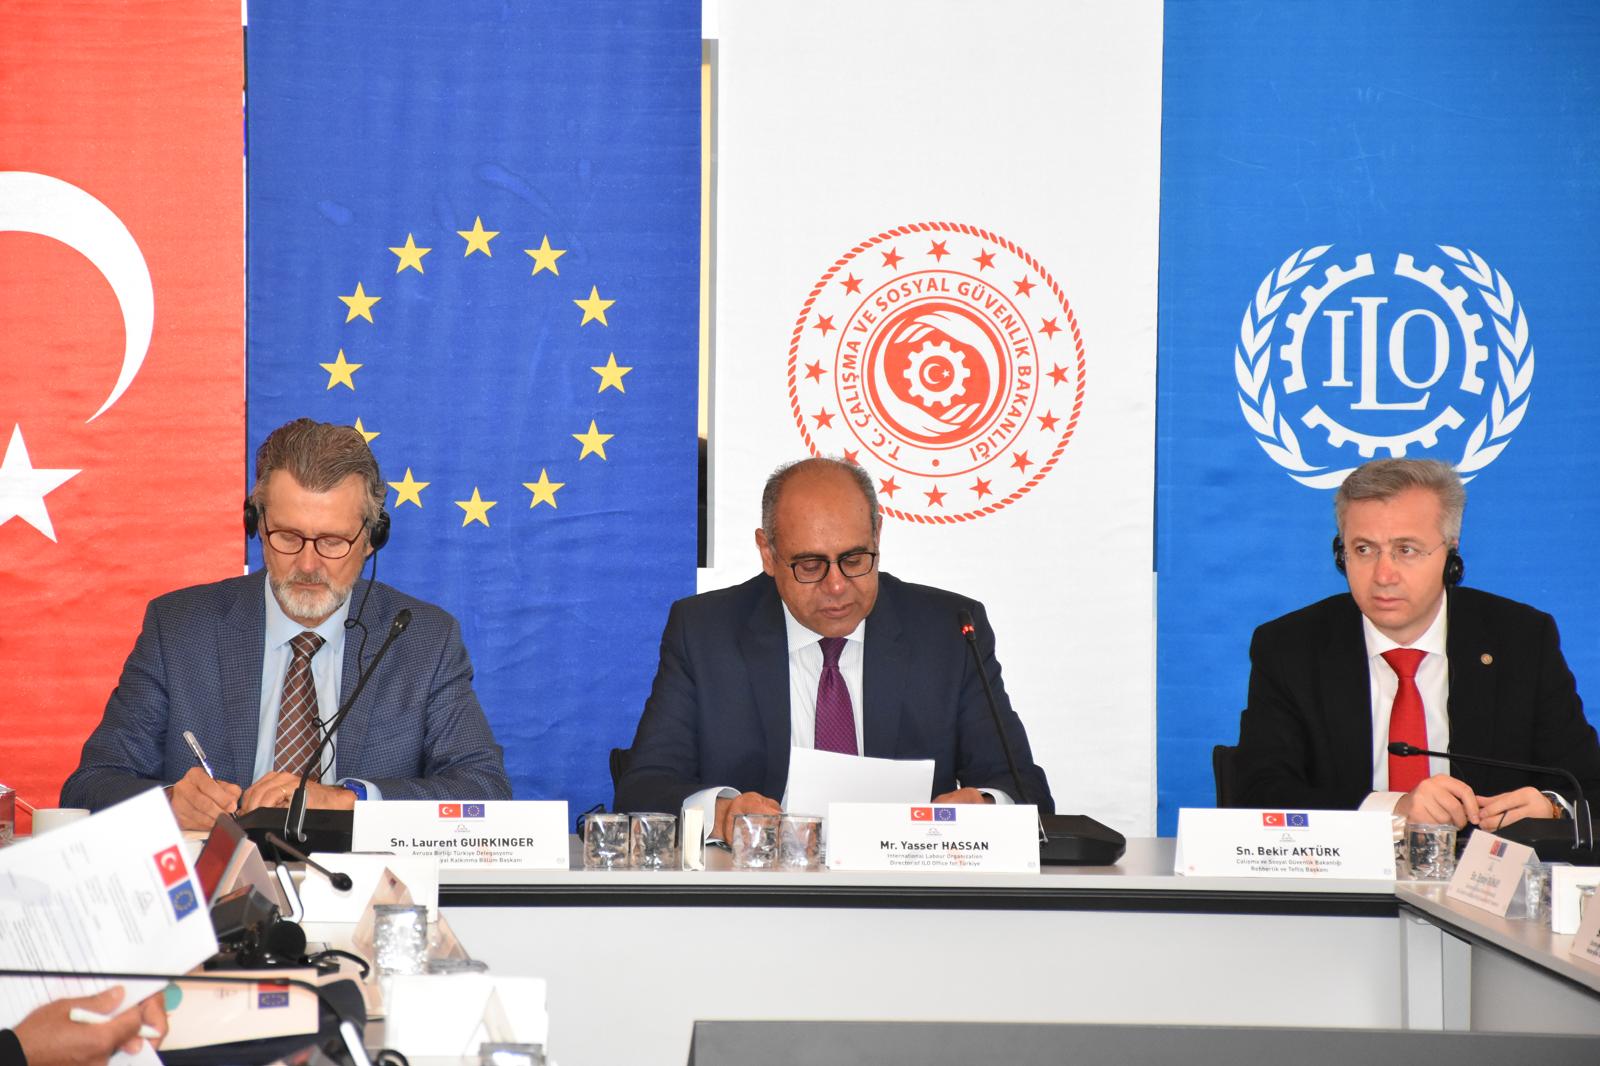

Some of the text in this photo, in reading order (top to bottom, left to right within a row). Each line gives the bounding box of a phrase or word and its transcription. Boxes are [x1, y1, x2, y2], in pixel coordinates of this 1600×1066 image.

[876, 277, 950, 312] SOSYAL
[855, 309, 877, 334] VE
[957, 279, 1031, 359] GÜVENLİK
[1322, 296, 1450, 411] ILO
[842, 340, 871, 428] ÇALIŞMA
[969, 365, 1032, 463] BAKANLIĞI
[390, 837, 534, 848] Sn. Laurent GUIRKINGER
[880, 840, 989, 850] Mr. Yasser HASSAN
[1236, 845, 1341, 857] Sn. Bekir AKTÜRK
